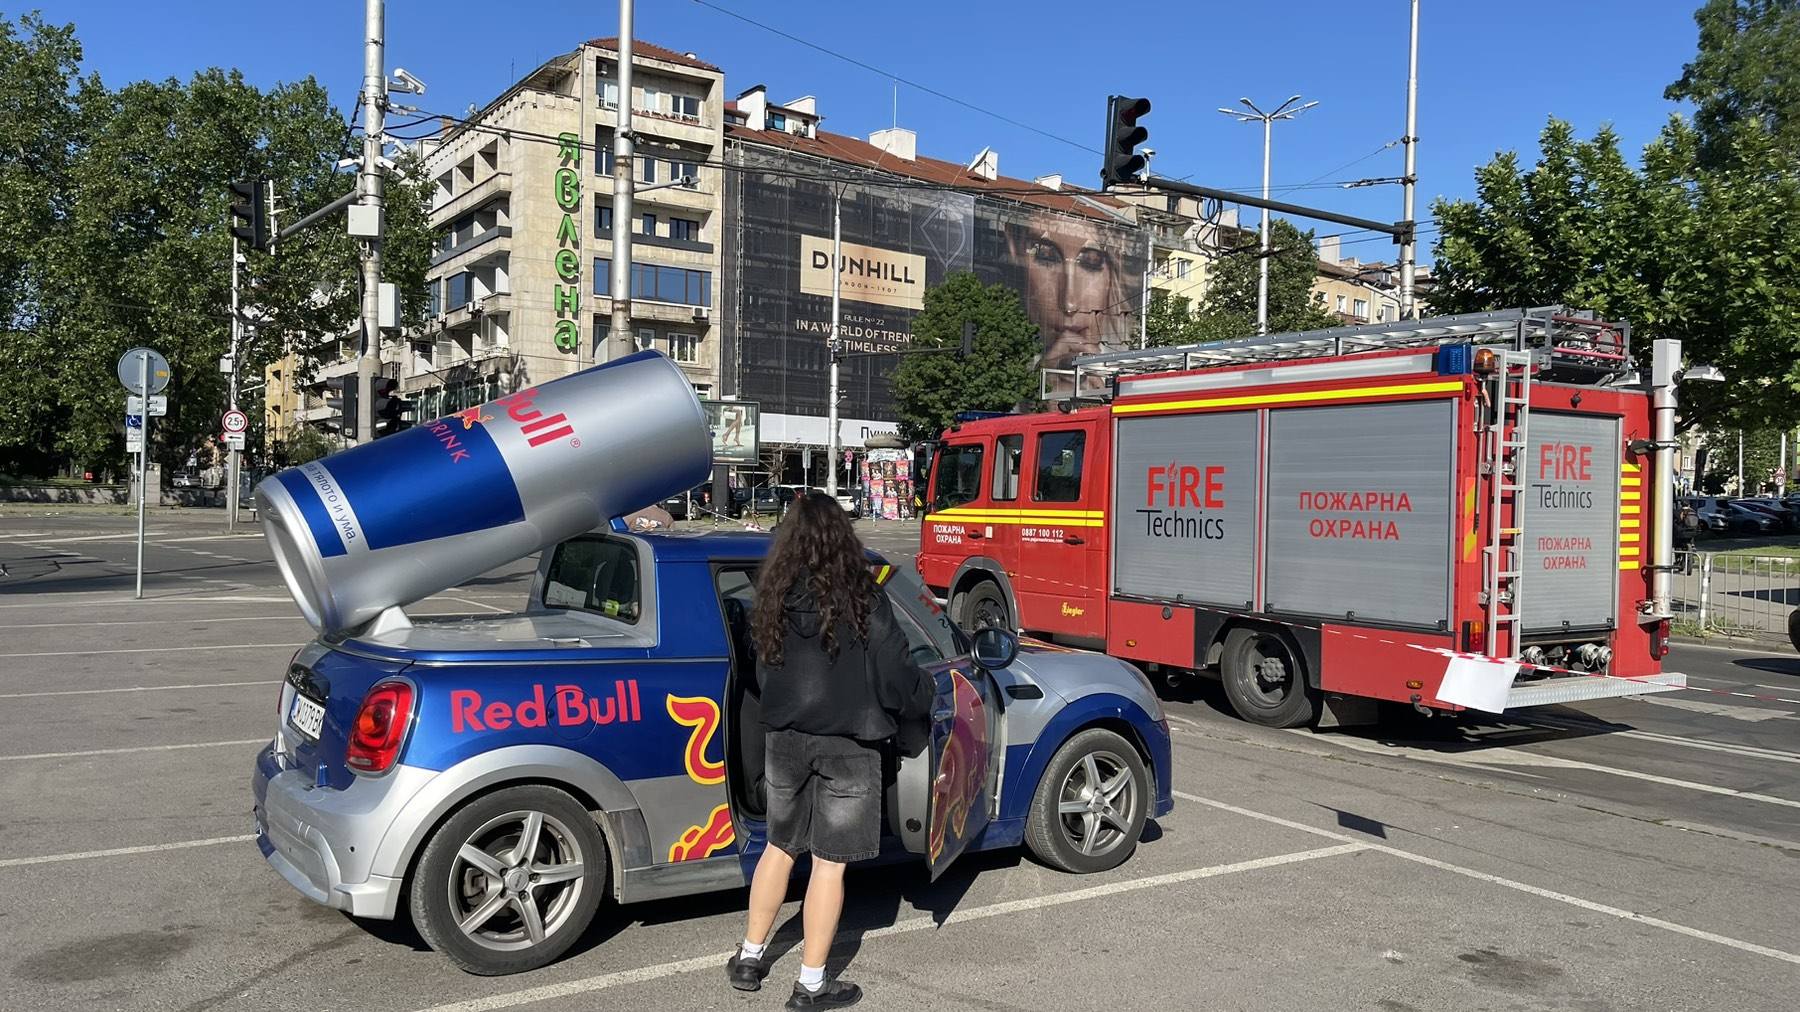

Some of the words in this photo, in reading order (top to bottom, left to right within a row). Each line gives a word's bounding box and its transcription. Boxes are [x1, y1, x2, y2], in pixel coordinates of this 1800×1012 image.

[812, 250, 916, 285] DUNHILL
[796, 319, 809, 330] IN
[810, 321, 819, 331] A
[821, 322, 863, 337] WRLD
[865, 328, 880, 338] OF
[844, 314, 864, 323] RULE
[876, 318, 885, 326] 22
[312, 470, 338, 503] тялото
[333, 504, 343, 513] и
[1299, 490, 1413, 513] ПОЖАРНА
[1532, 484, 1592, 509] Technics
[933, 524, 965, 535] ПОЖАРНА
[1021, 528, 1037, 537] 0887
[1038, 528, 1050, 538] 100
[1051, 529, 1064, 538] 112
[1136, 509, 1224, 540] Technics
[1309, 518, 1400, 541] ОХРАНА
[936, 534, 962, 544] ОХРАНА
[1538, 537, 1592, 551] ПОЖАРНА
[1543, 556, 1586, 570] ОХРАНА
[451, 683, 548, 733] Red
[555, 679, 641, 727] Bull
